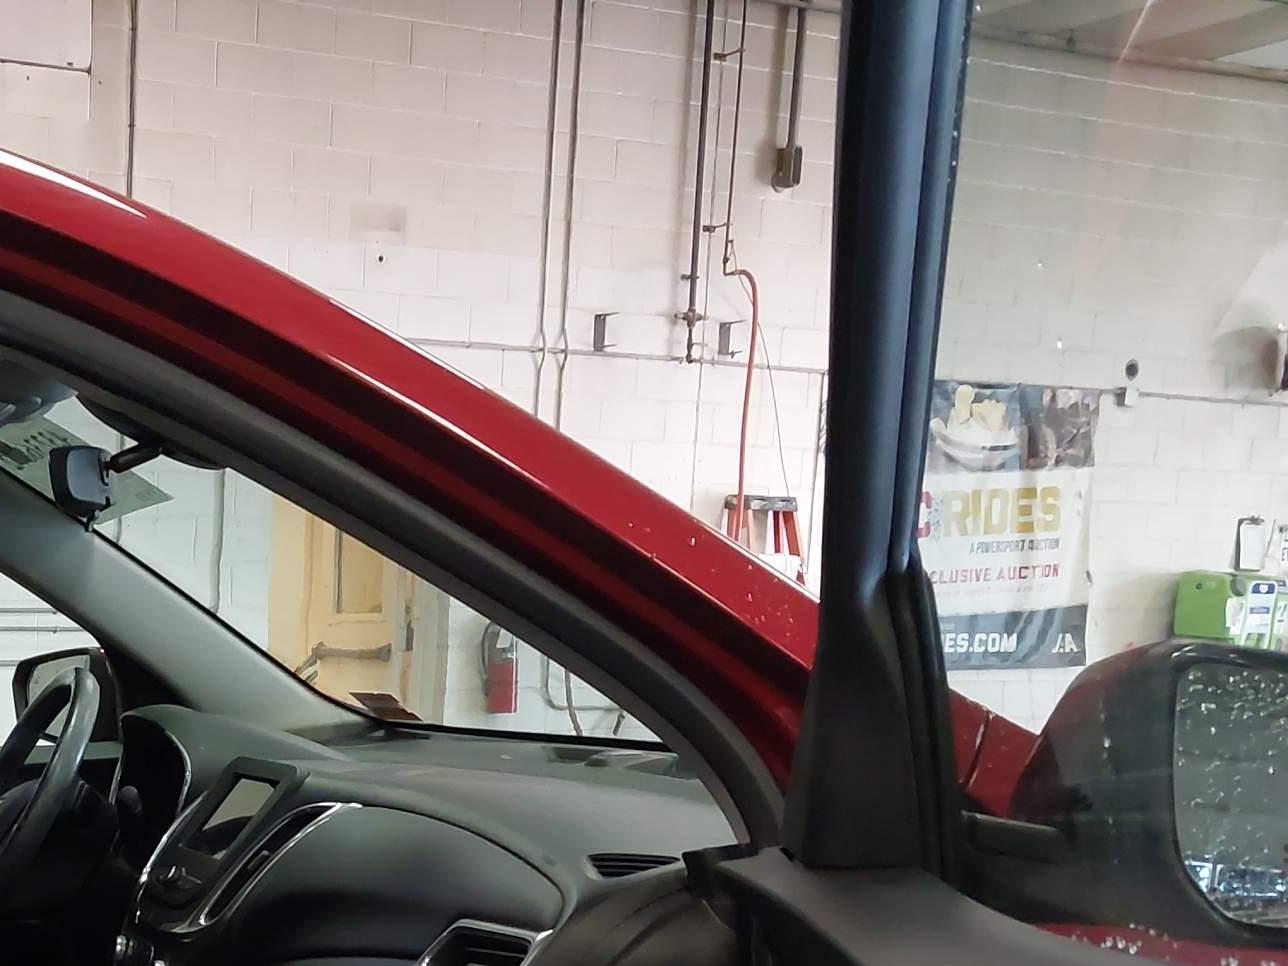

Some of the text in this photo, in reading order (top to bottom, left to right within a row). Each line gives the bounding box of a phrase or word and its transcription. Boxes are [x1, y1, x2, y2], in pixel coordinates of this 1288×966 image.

[943, 485, 1062, 538] RIDES
[1027, 536, 1061, 553] AUCTION
[996, 563, 1060, 582] AUCTION
